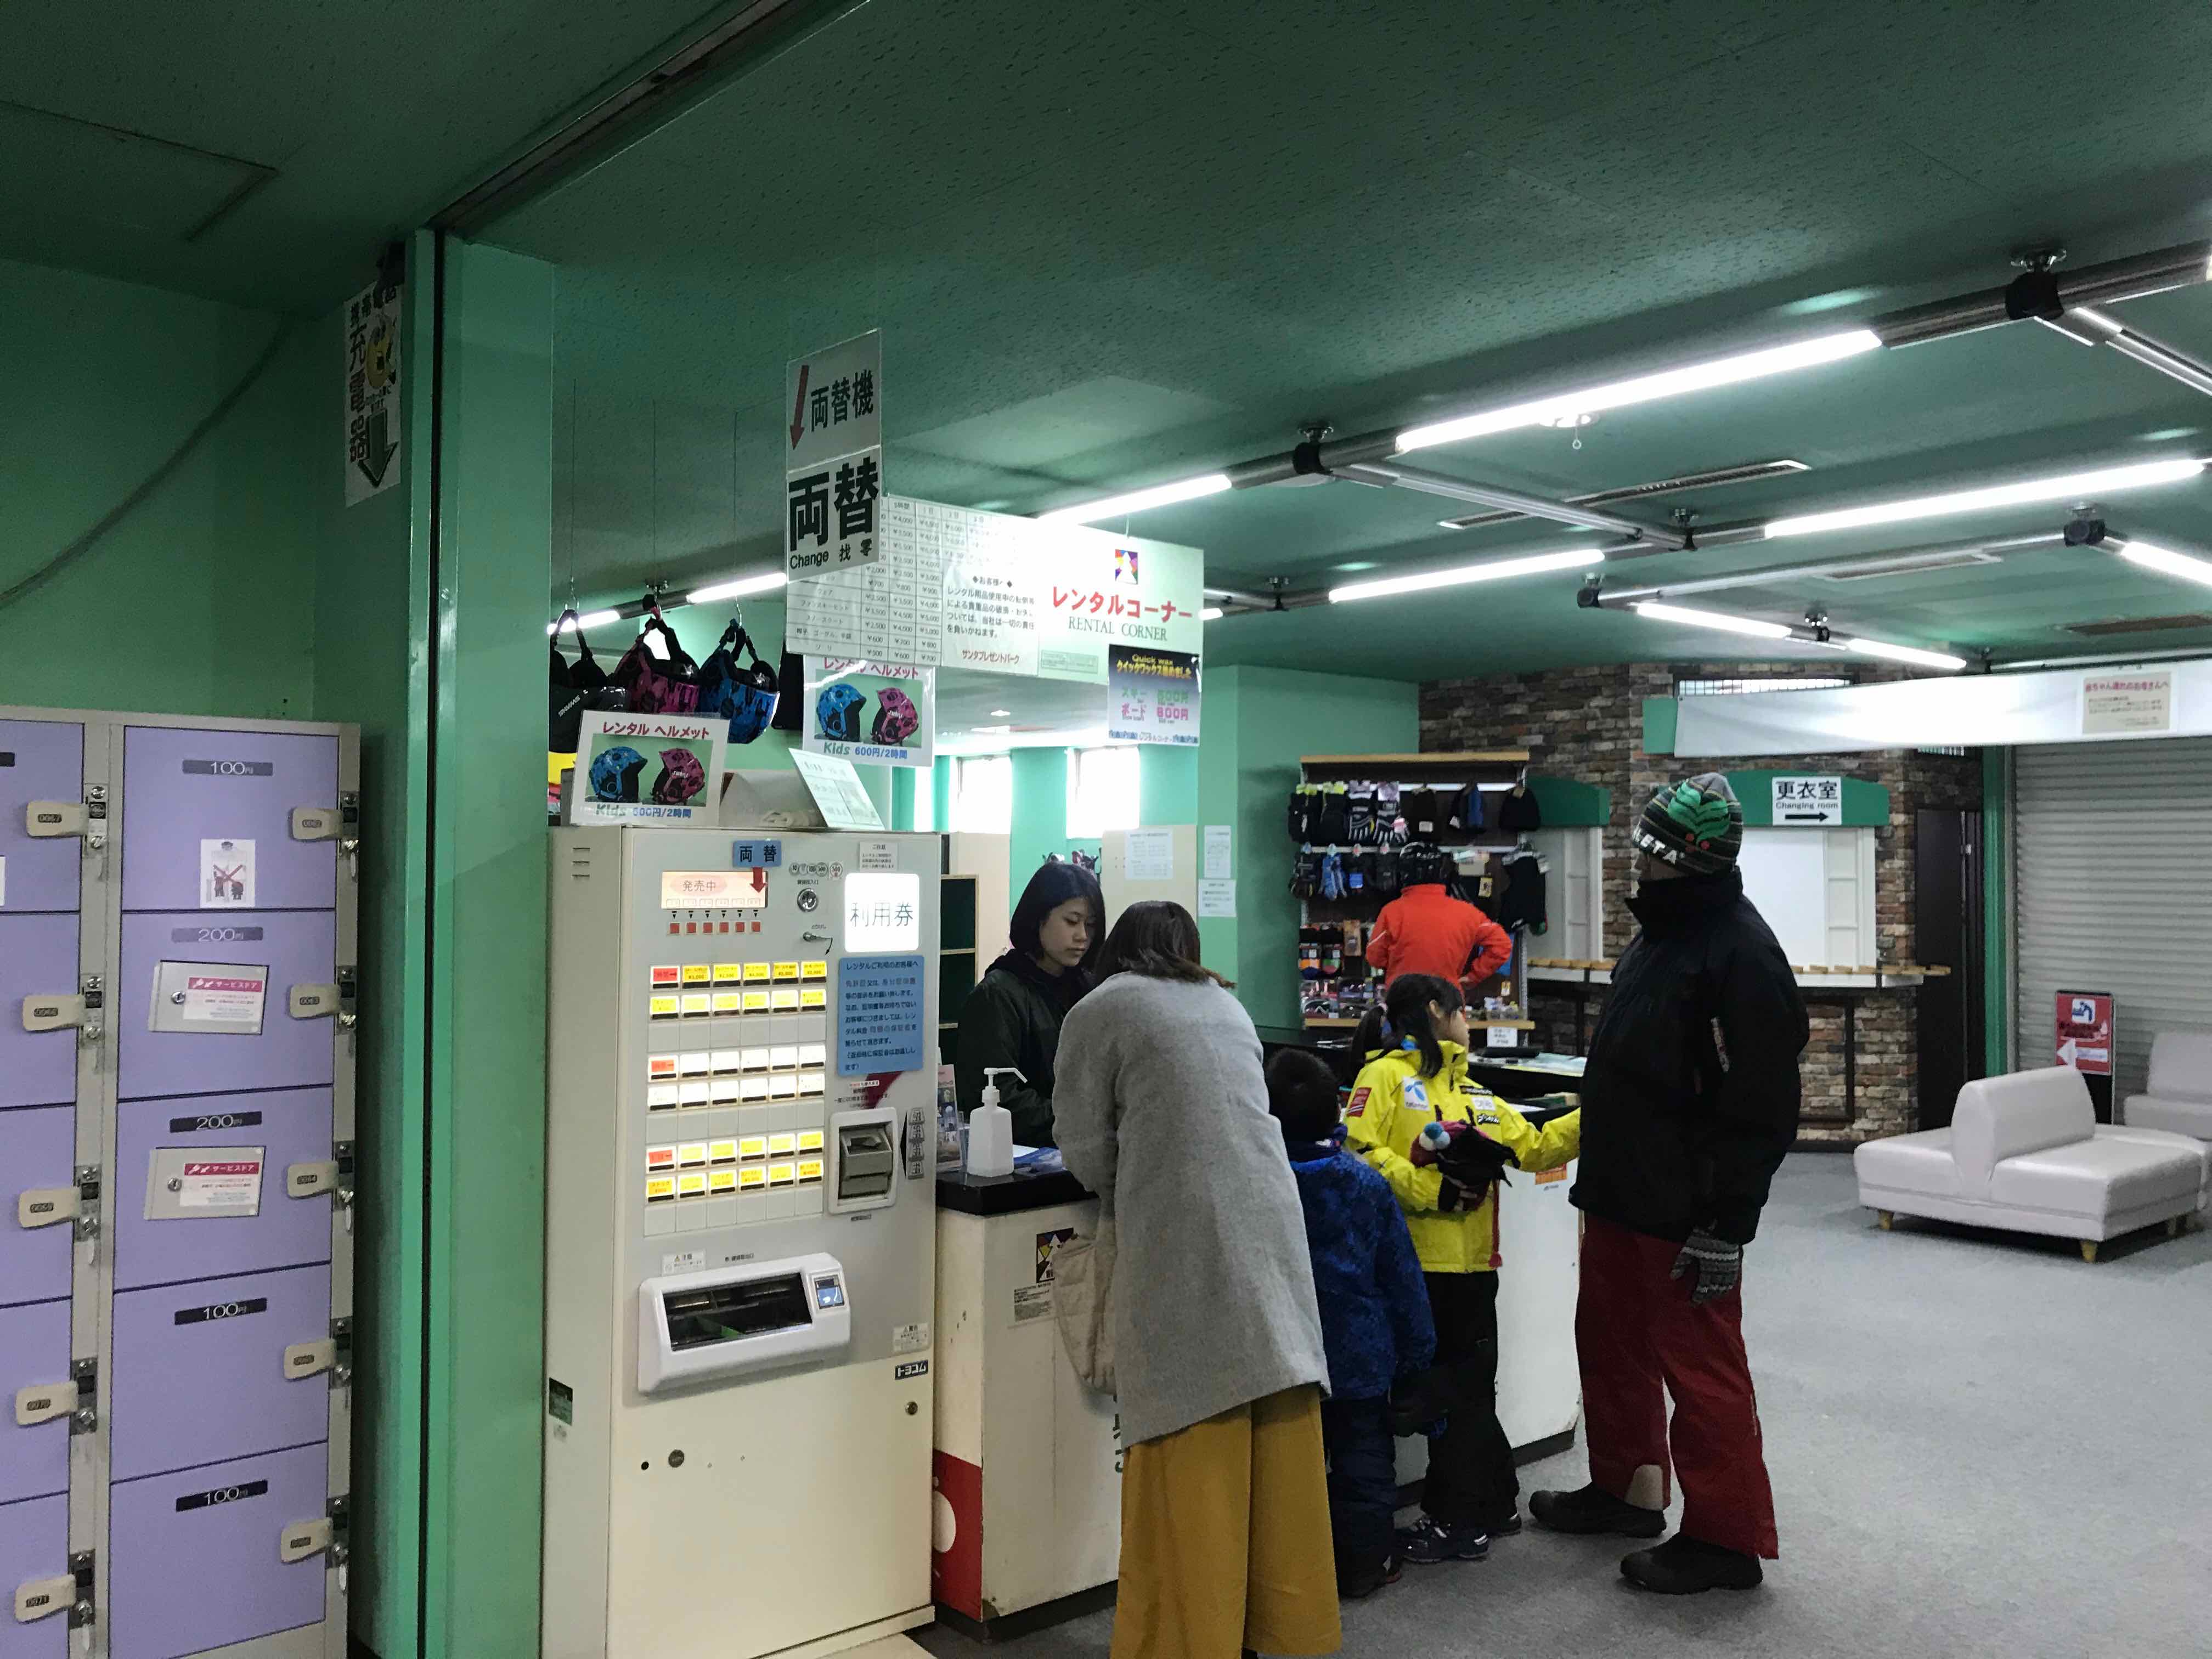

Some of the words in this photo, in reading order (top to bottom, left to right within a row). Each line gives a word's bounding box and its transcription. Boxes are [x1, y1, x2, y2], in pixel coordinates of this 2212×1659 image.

[810, 369, 873, 433] 両替機
[789, 456, 878, 552] 両替
[789, 550, 829, 569] Change
[1053, 586, 1193, 623] レンタルコーナー
[1068, 617, 1115, 634] RENTAL
[1121, 623, 1168, 641] CORNER
[962, 650, 1020, 664] サンタプレゼントパーク
[871, 664, 918, 679] ヘルメット
[602, 721, 650, 735] レンタル
[654, 725, 709, 740] ヘルメット
[823, 742, 850, 755] Kids
[855, 747, 908, 760] 600円/2時間
[1775, 780, 1838, 800] 更衣室
[738, 845, 778, 863] 両替
[682, 879, 717, 892] 発売中
[850, 901, 914, 928] 利用券
[216, 980, 258, 989] サービスドア
[212, 1164, 255, 1172] サービスドア
[898, 1363, 926, 1377] トヨコム
